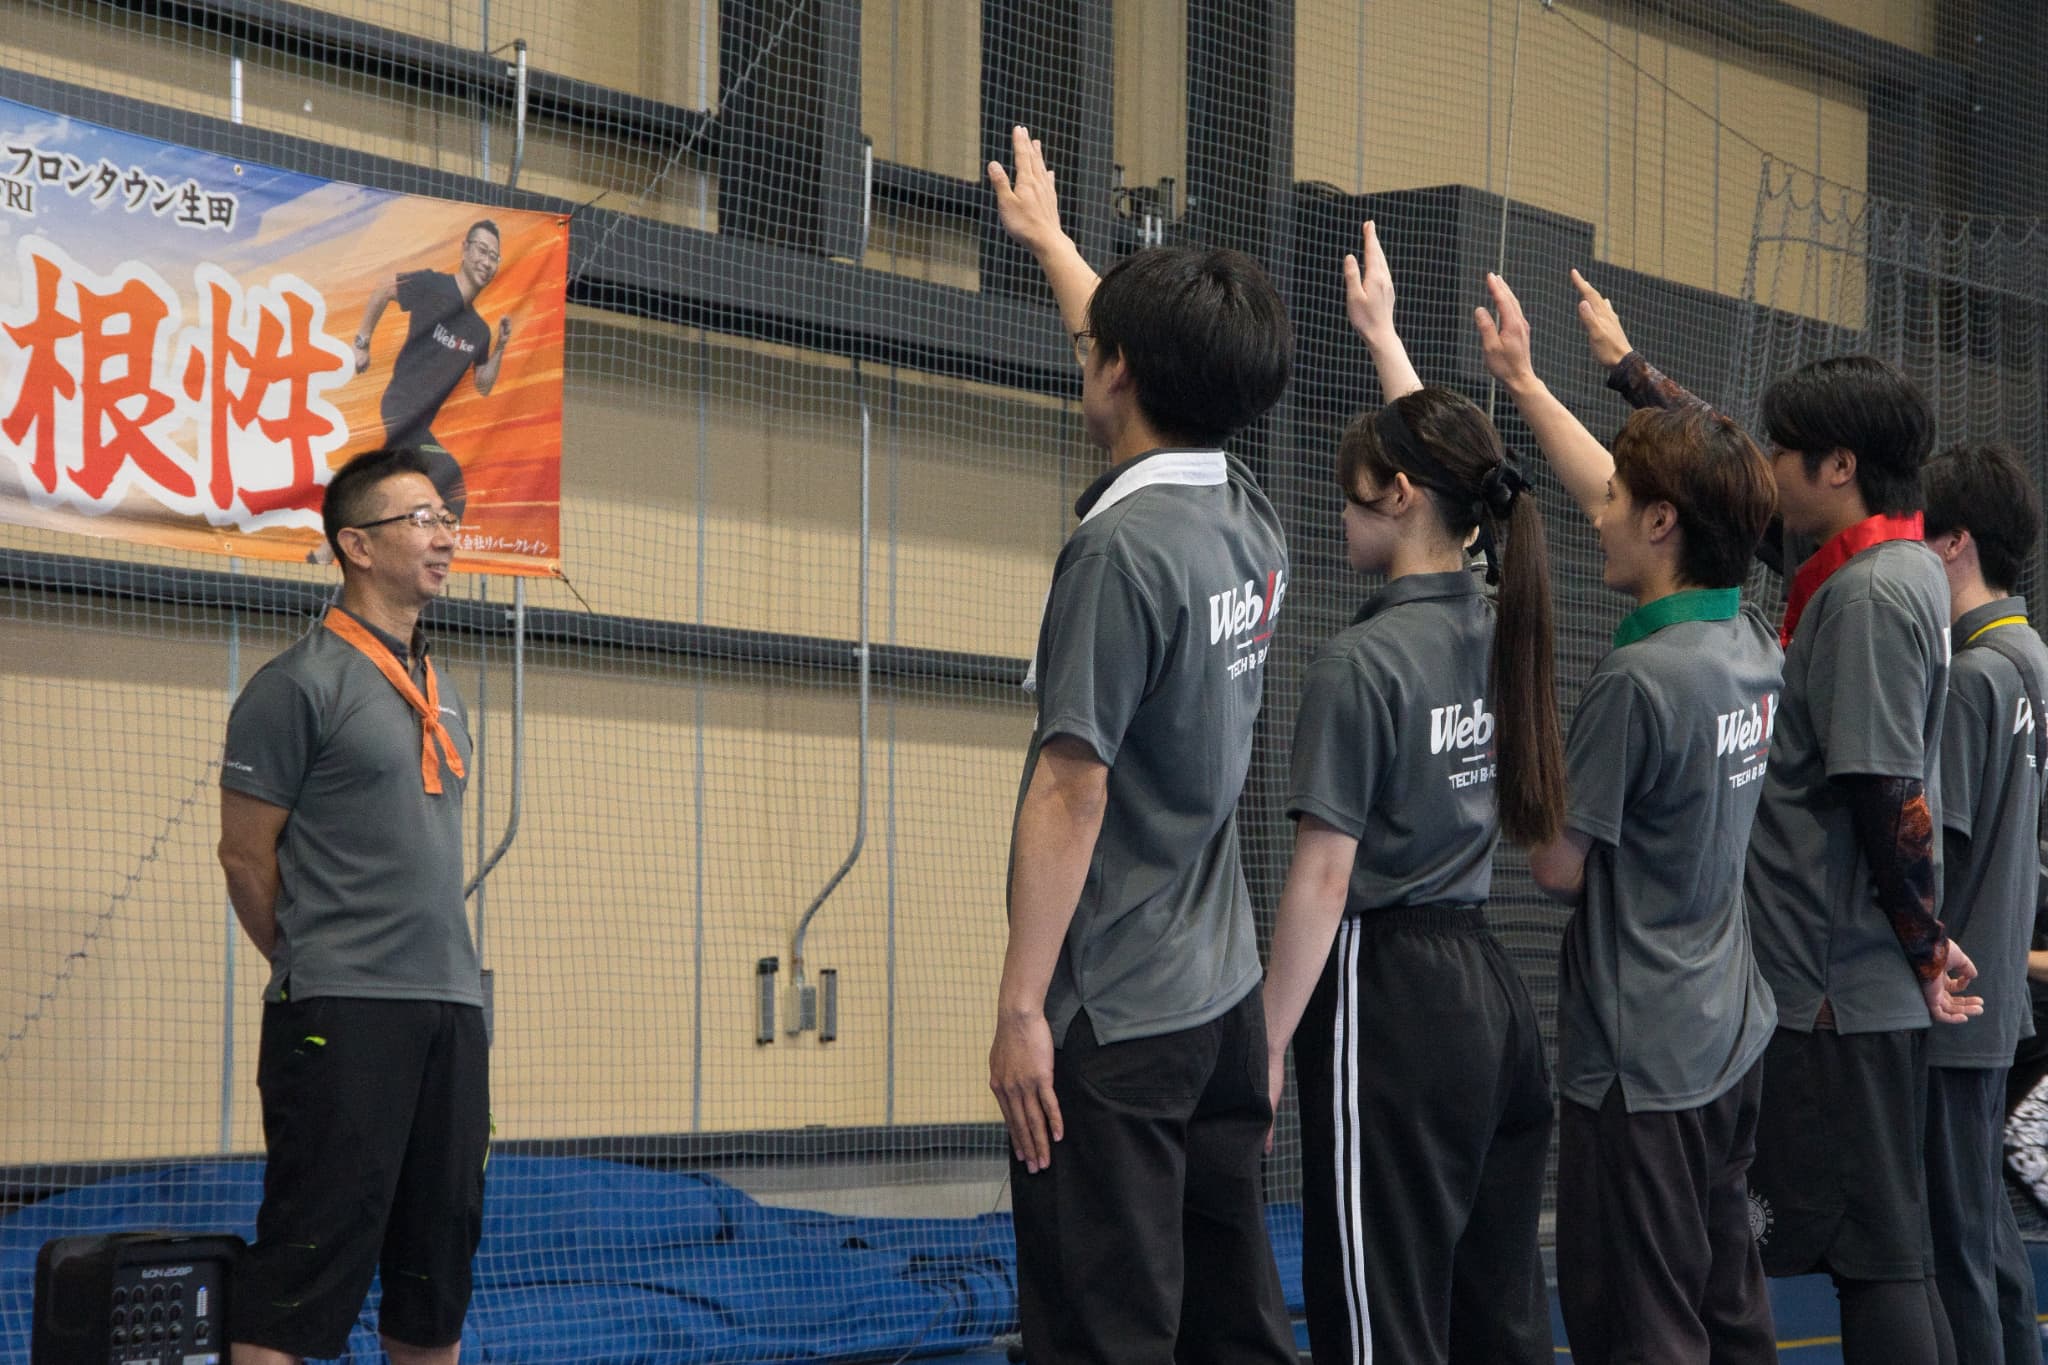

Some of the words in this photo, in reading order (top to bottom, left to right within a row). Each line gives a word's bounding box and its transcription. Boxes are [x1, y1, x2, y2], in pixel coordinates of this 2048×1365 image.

[7, 145, 235, 227] フロンタウン生田
[1, 252, 344, 517] 根性
[1227, 656, 1248, 680] TECH
[1448, 770, 1479, 790] TECH
[1728, 768, 1751, 789] TECH
